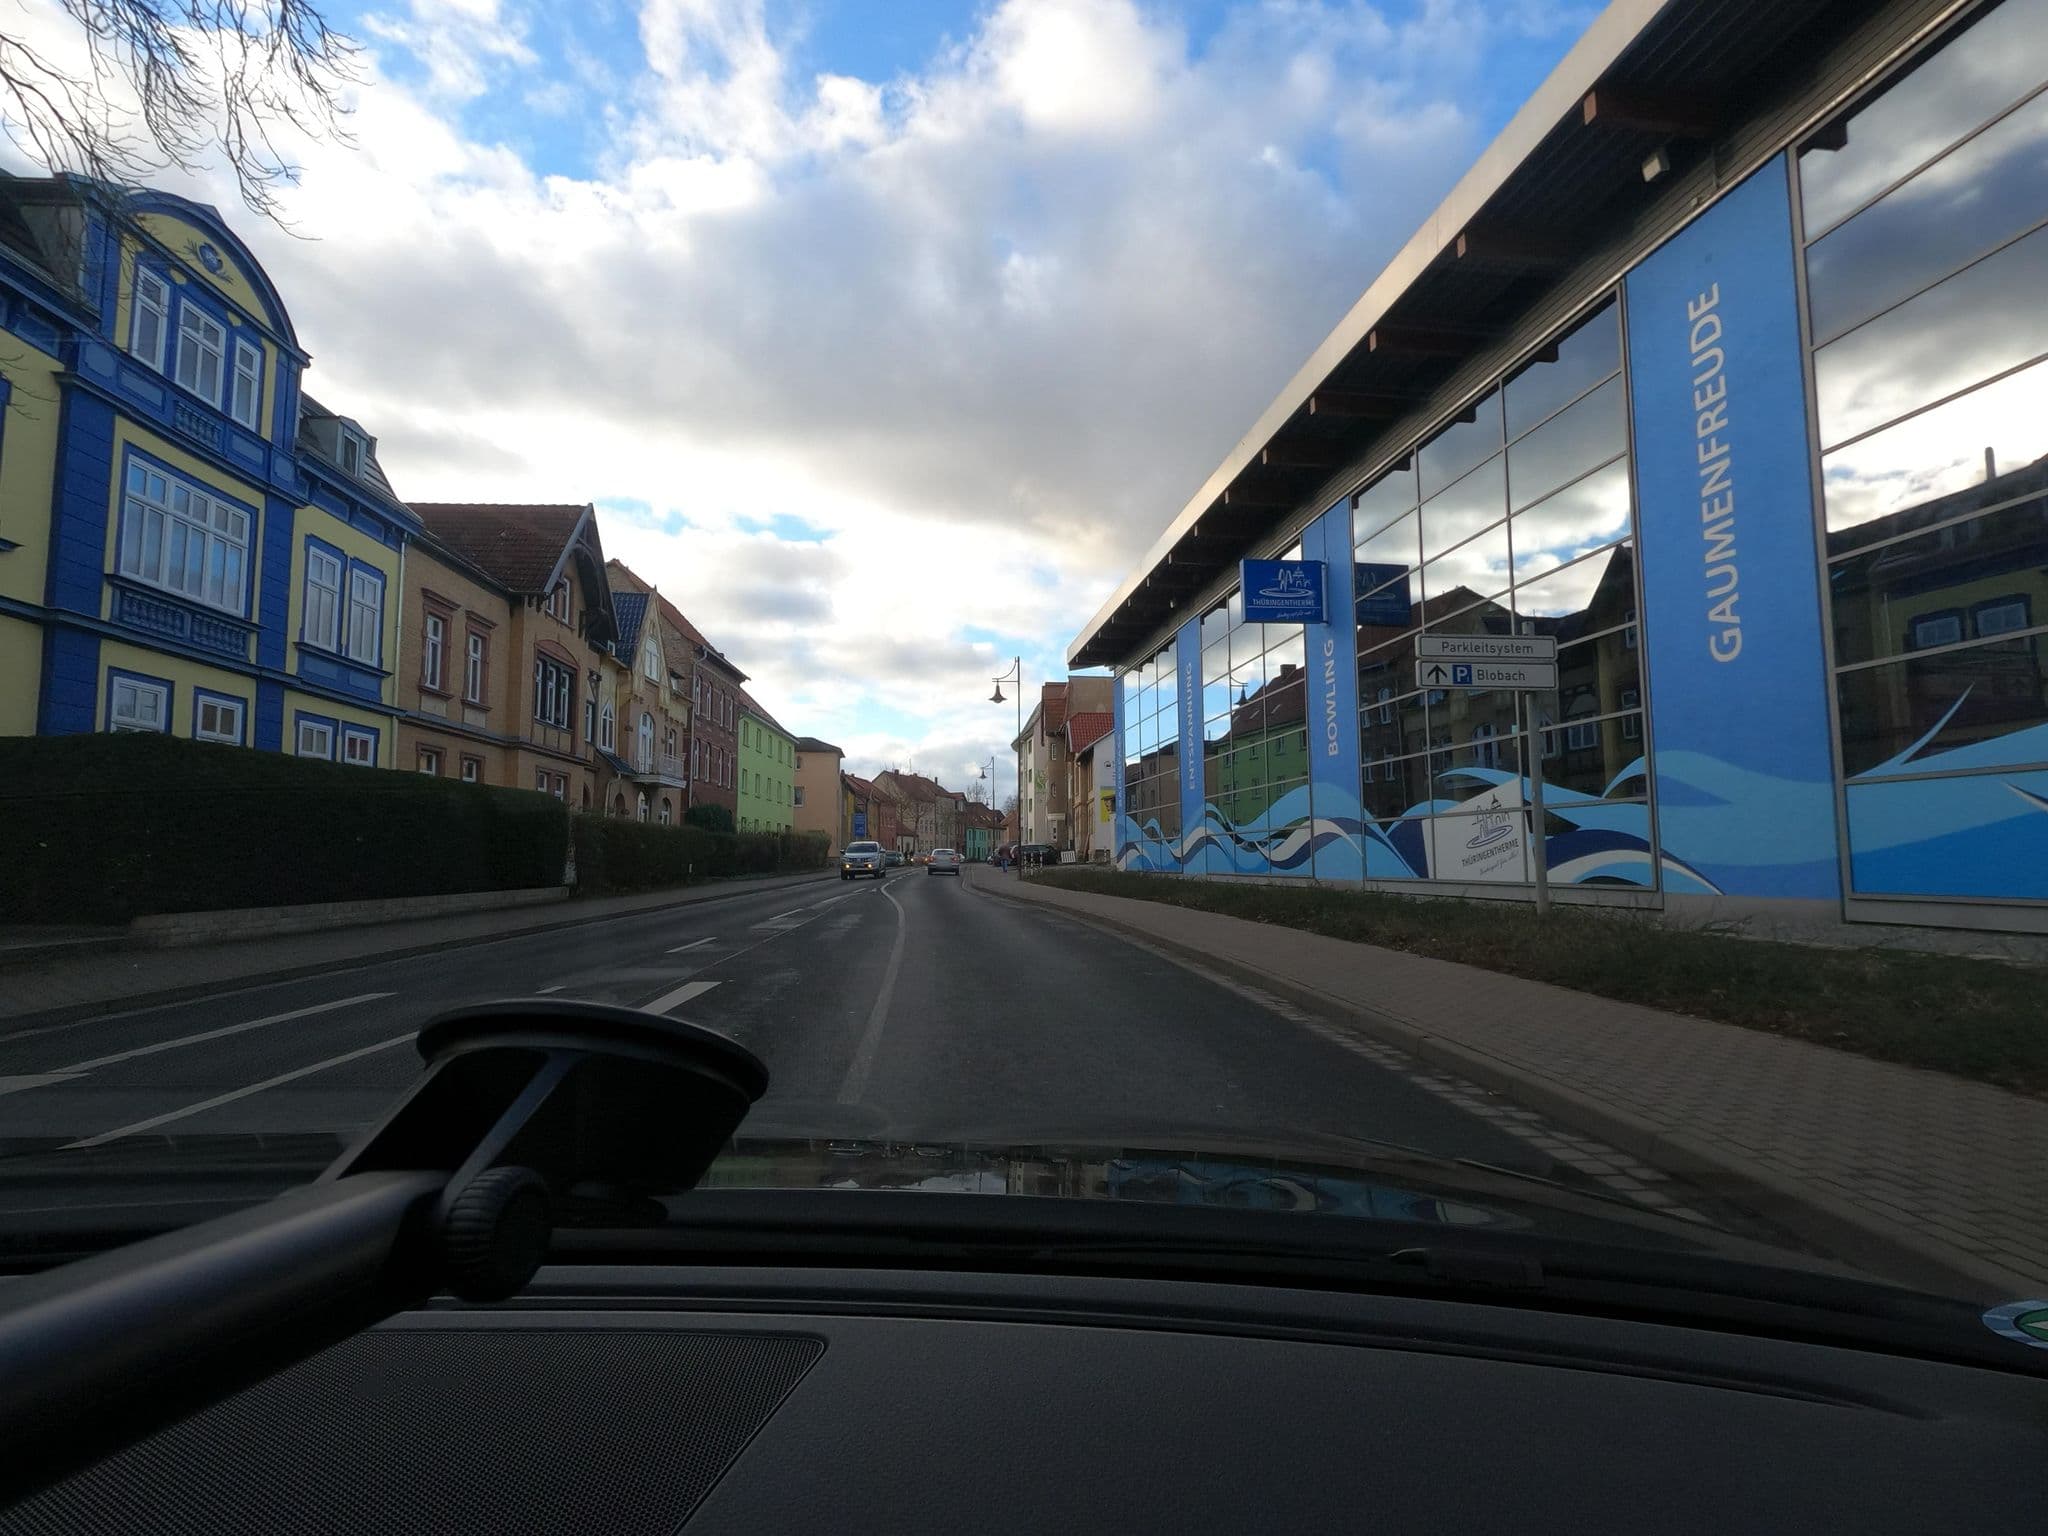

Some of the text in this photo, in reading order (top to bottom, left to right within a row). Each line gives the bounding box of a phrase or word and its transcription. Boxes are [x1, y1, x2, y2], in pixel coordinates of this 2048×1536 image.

[1688, 281, 1742, 663] GAUMENFREUDE
[1252, 597, 1315, 607] THÜRINGENTHERME
[1441, 641, 1534, 655] Parkleitsystem
[1477, 669, 1526, 681] Blobach
[1185, 662, 1195, 790] ENTSPANNUNG
[1324, 639, 1339, 756] BOWLING
